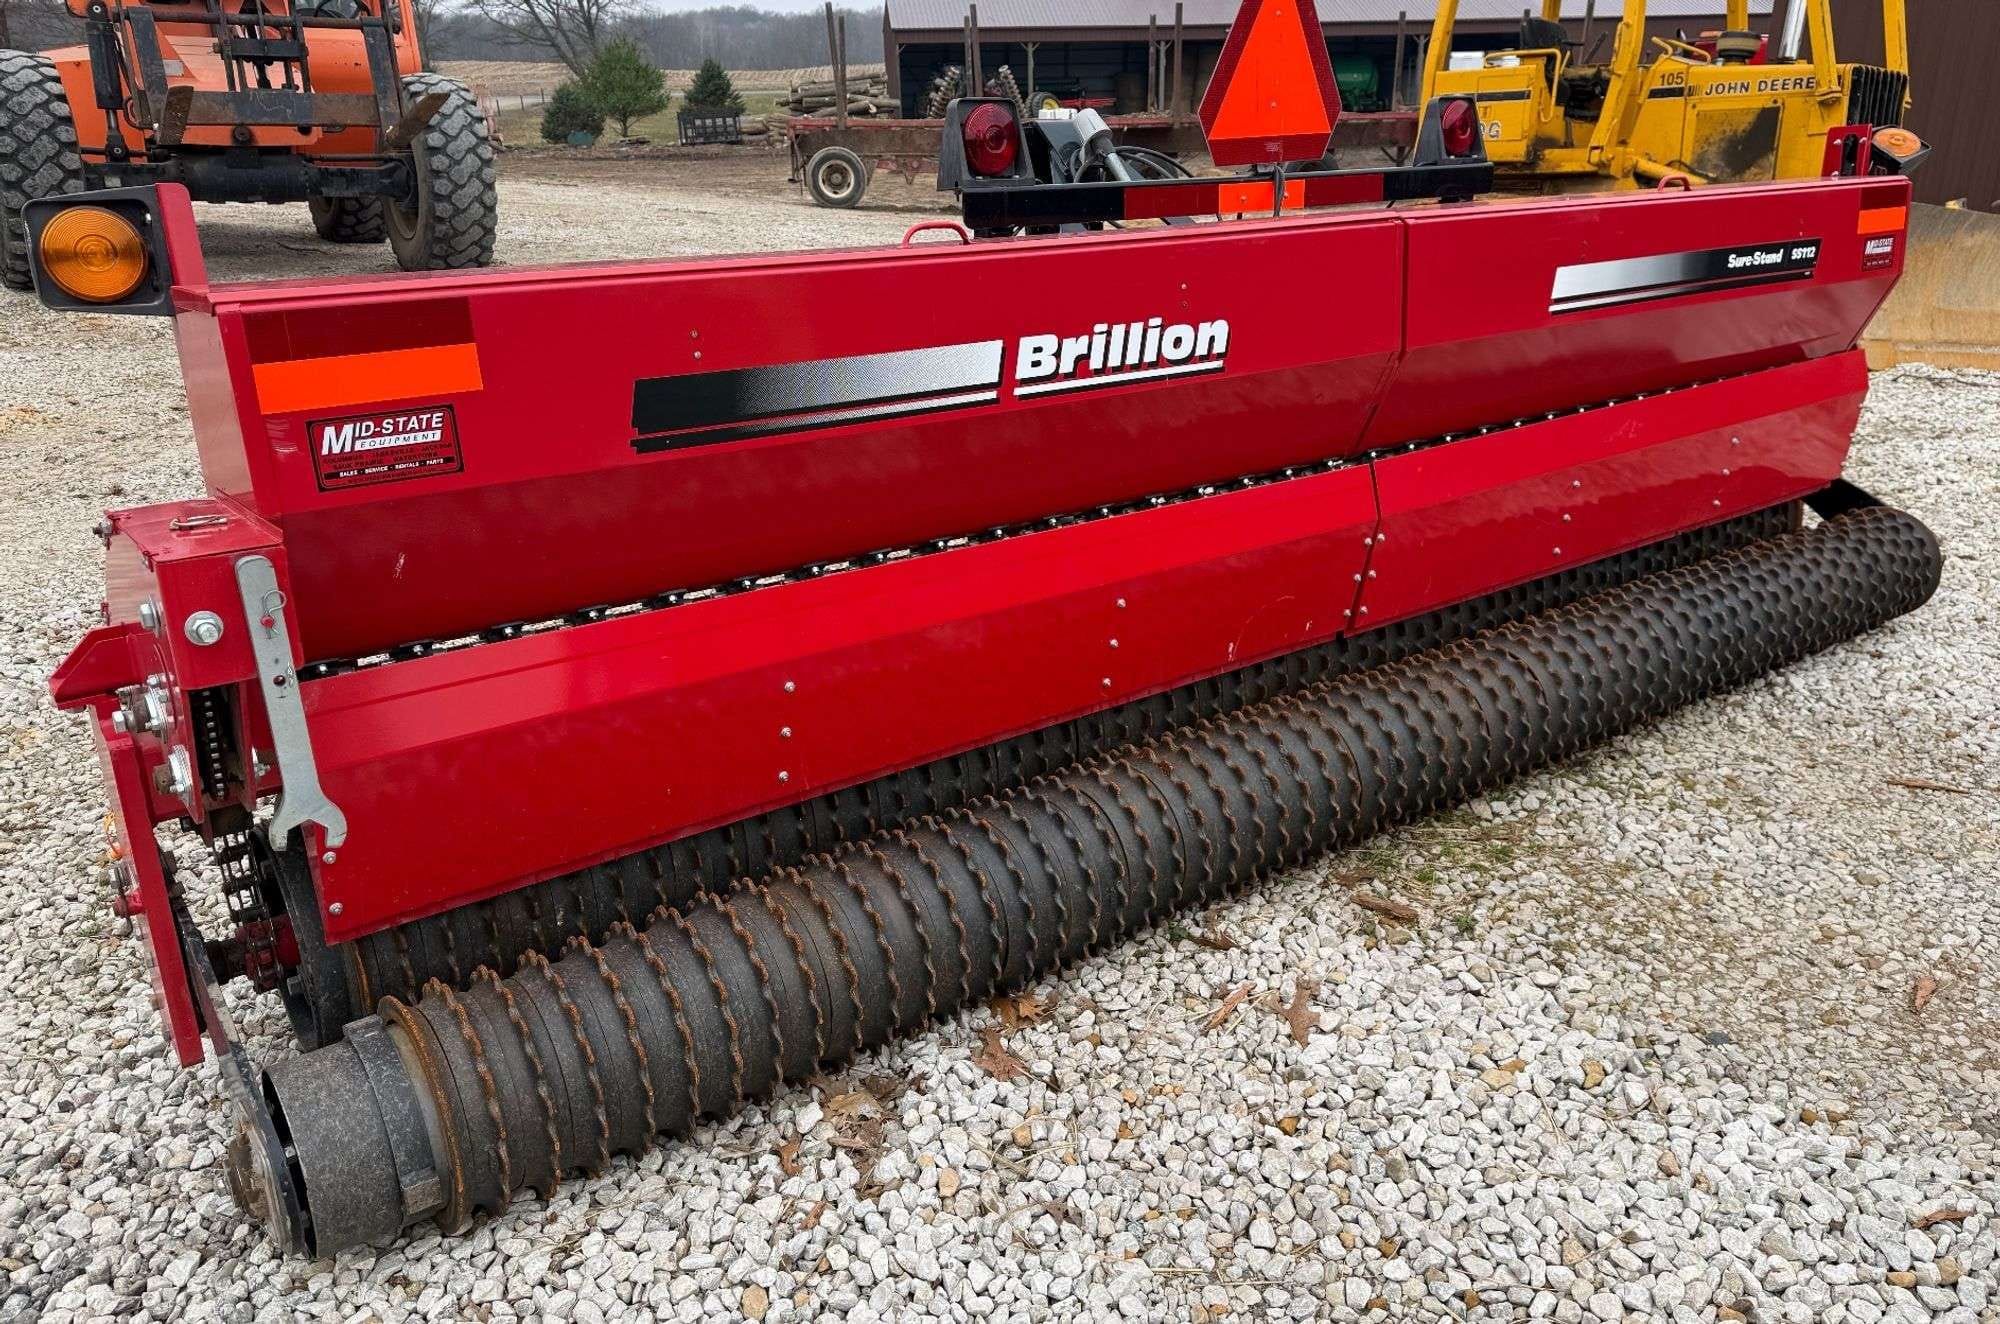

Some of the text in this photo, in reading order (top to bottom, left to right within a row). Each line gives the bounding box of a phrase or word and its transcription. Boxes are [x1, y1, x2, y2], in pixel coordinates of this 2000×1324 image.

[1659, 71, 1684, 87] 105
[1704, 76, 1817, 96] JOHN DEERE
[1015, 317, 1230, 382] Brillion
[321, 412, 443, 455] MID-STATE
[359, 431, 438, 449] EQUIPMENT
[339, 470, 358, 478] SALES
[364, 465, 388, 474] SERVICE
[394, 461, 419, 470] RENTALS
[425, 458, 444, 466] PARTS
